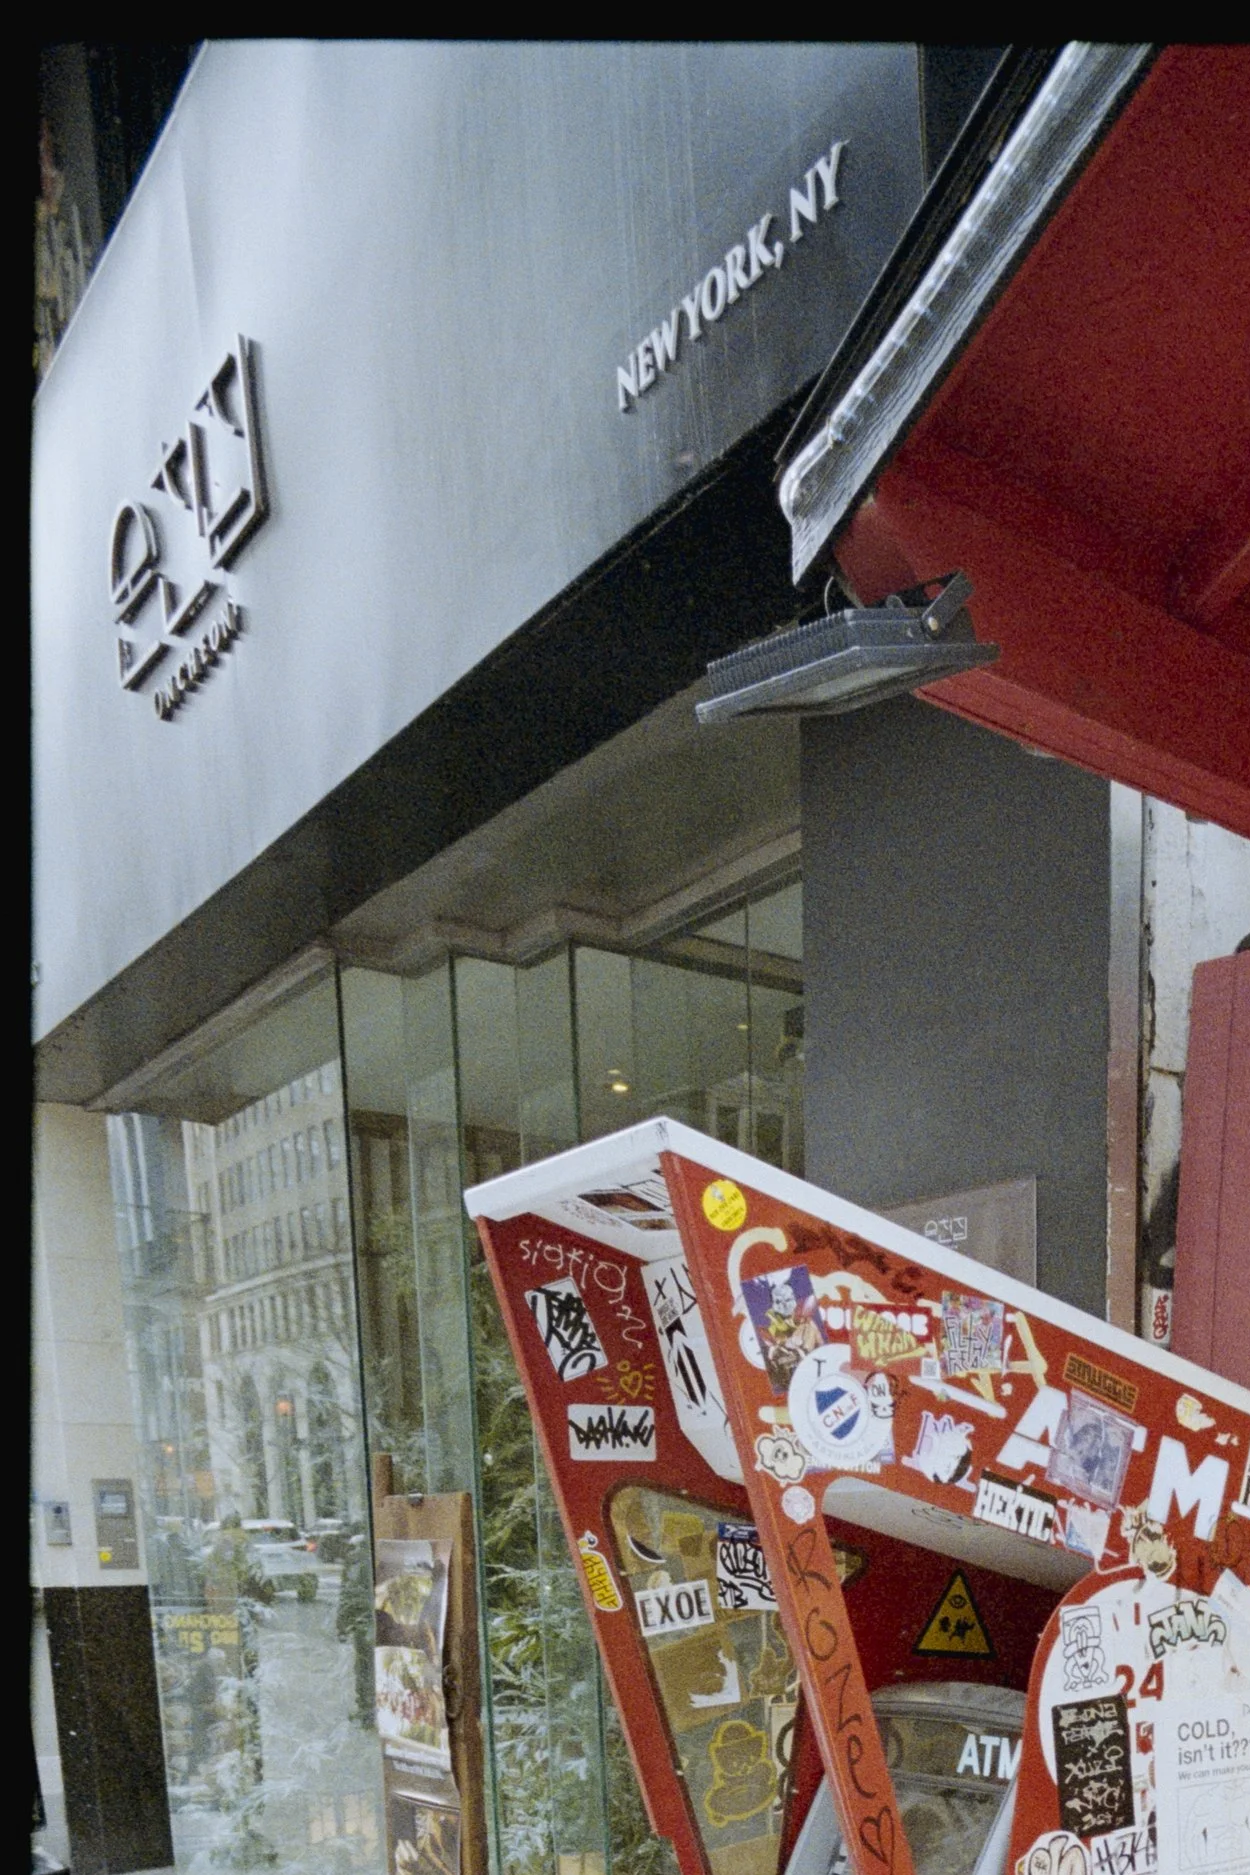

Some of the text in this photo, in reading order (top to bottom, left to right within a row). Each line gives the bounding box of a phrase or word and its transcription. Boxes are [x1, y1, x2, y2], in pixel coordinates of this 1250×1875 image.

[617, 139, 850, 412] NEW YORK, NY
[640, 1586, 712, 1629] EXOE
[1178, 1719, 1236, 1742] COLD,
[1178, 1742, 1220, 1766] isn't
[1178, 1770, 1192, 1781] We
[1194, 1769, 1211, 1779] can
[1213, 1764, 1235, 1776] make
